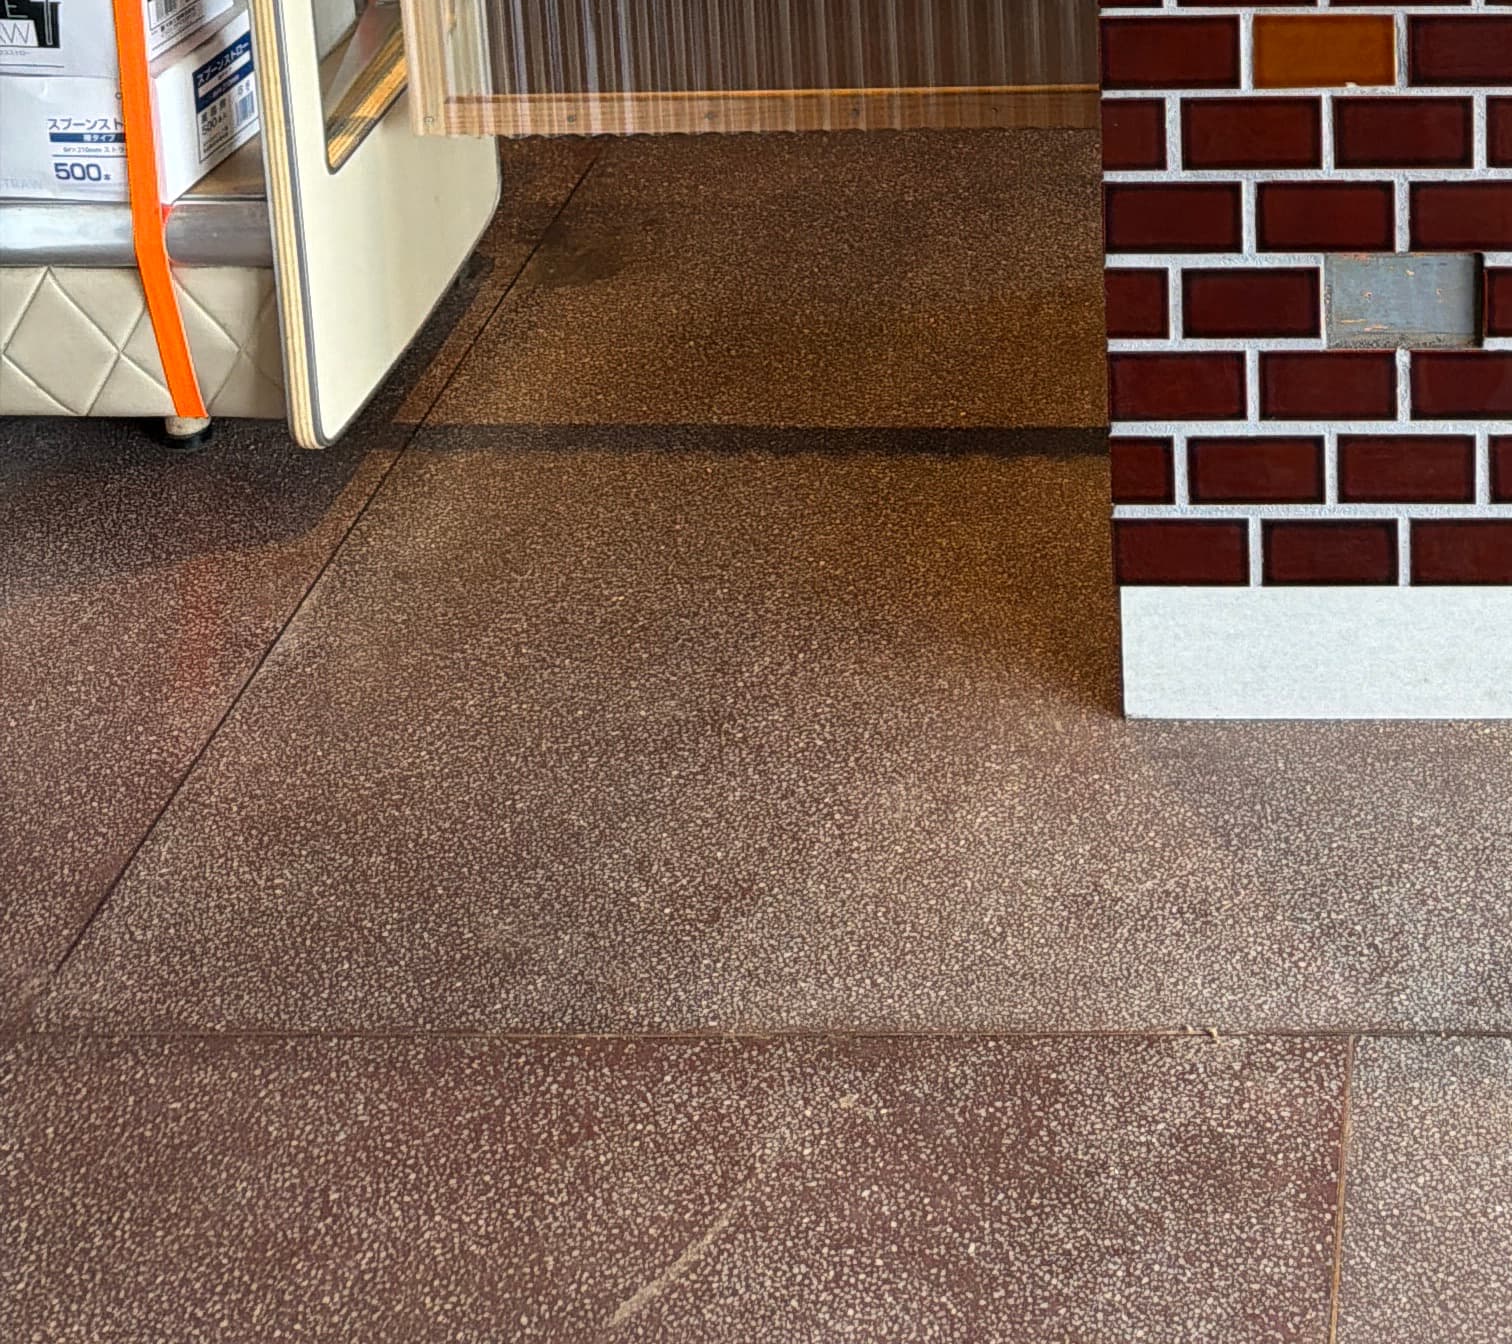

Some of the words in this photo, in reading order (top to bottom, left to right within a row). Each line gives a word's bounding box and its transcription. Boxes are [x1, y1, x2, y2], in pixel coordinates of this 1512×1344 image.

[48, 117, 124, 131] スプーンスト
